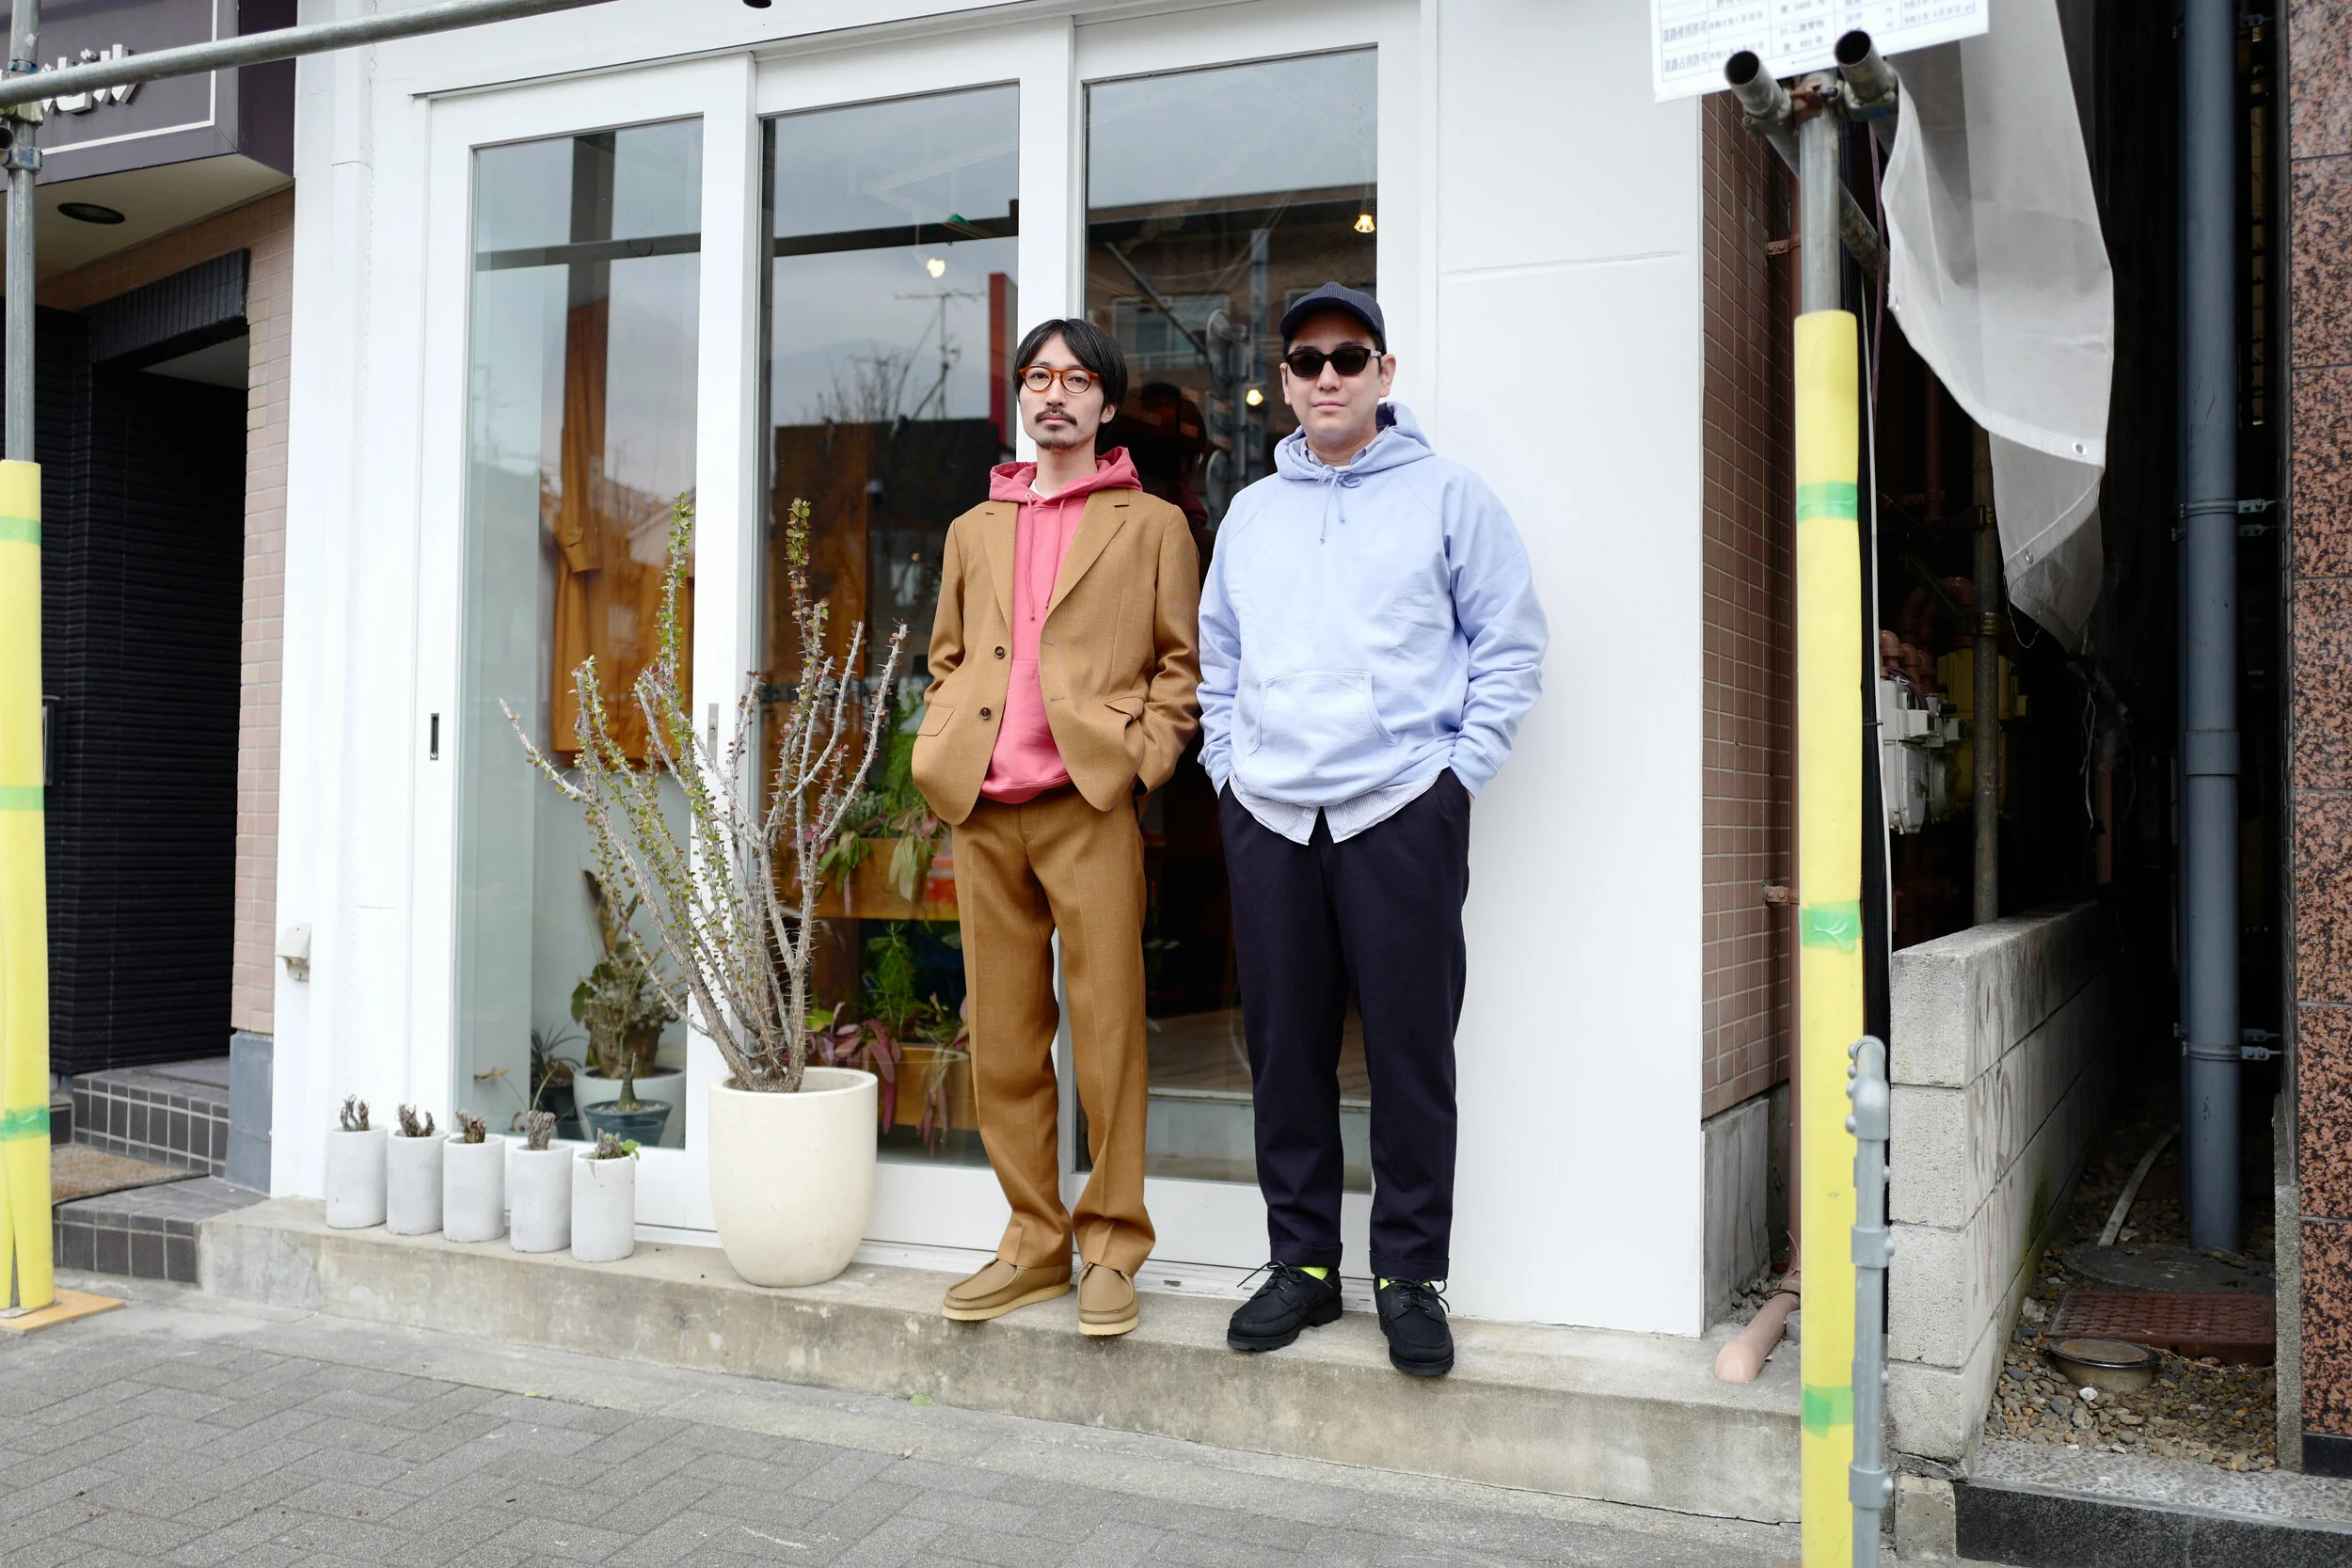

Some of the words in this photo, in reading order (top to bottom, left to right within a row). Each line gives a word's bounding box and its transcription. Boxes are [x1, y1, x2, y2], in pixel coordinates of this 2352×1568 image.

[1662, 21, 1707, 43] 道路使用許可
